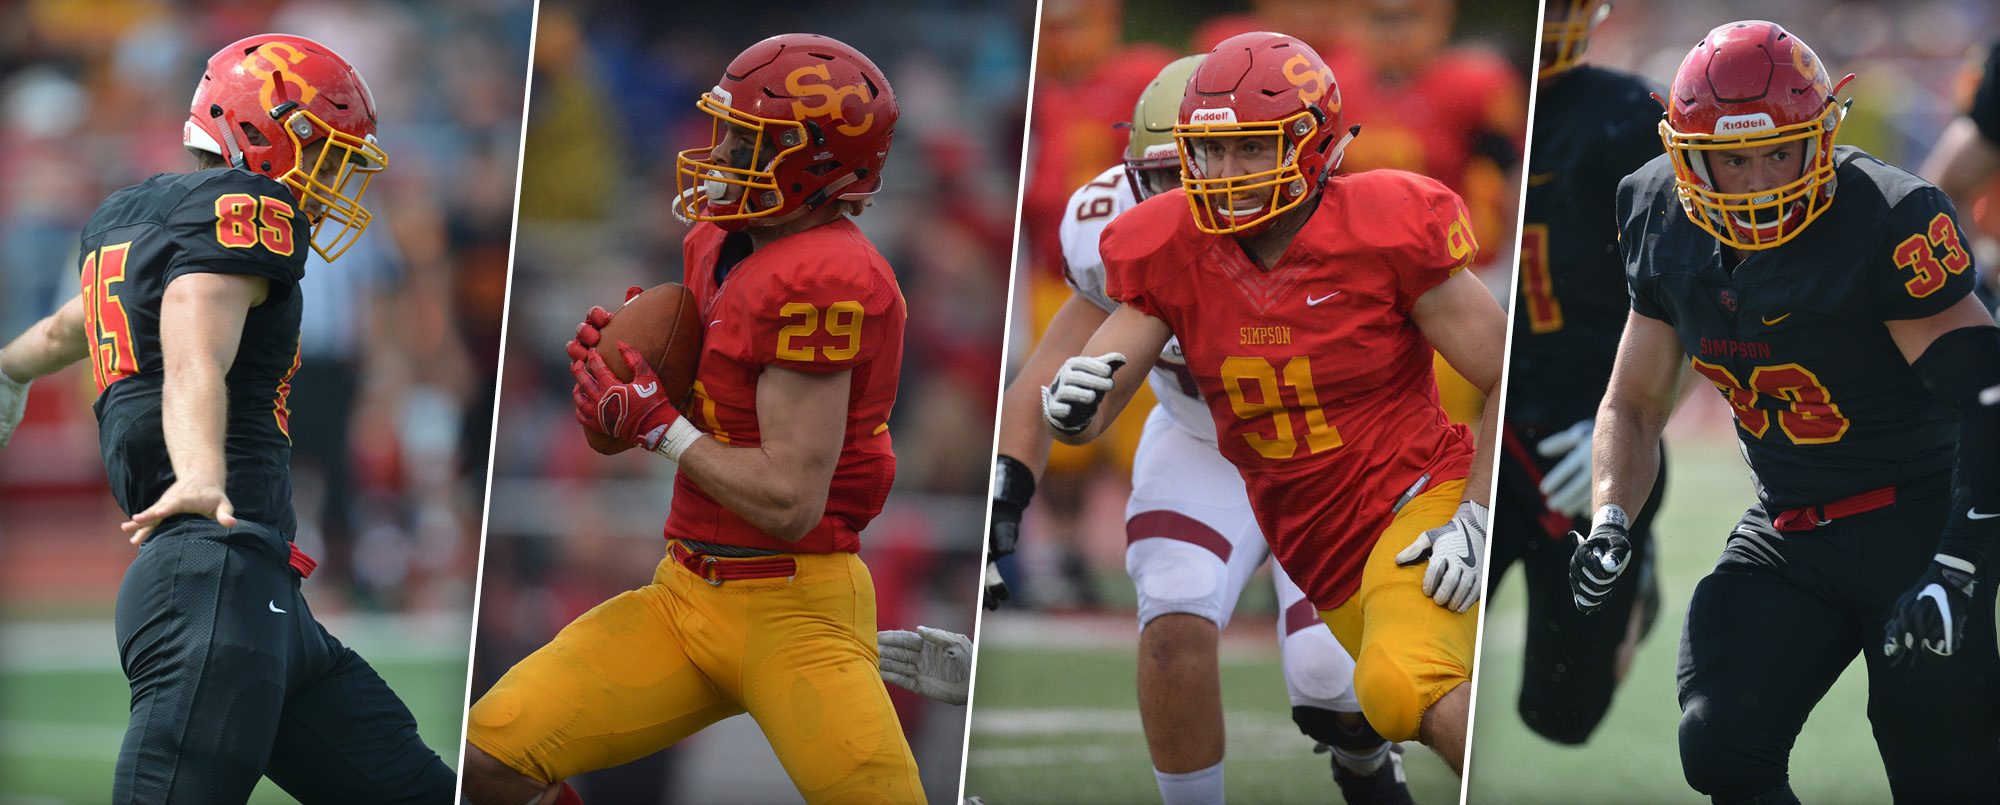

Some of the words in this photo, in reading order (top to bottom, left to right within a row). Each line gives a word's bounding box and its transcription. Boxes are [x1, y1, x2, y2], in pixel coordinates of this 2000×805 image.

[785, 64, 873, 136] SC
[1194, 112, 1228, 121] Riddell
[1723, 119, 1766, 130] Riddell
[215, 193, 295, 257] 85
[1076, 174, 1124, 222] 79
[1447, 208, 1479, 277] 91
[1893, 212, 1970, 298] 33
[776, 300, 864, 361] 29
[1240, 326, 1291, 345] SIMPSON
[1700, 337, 1771, 358] SIMPSON
[1220, 355, 1343, 459] 91
